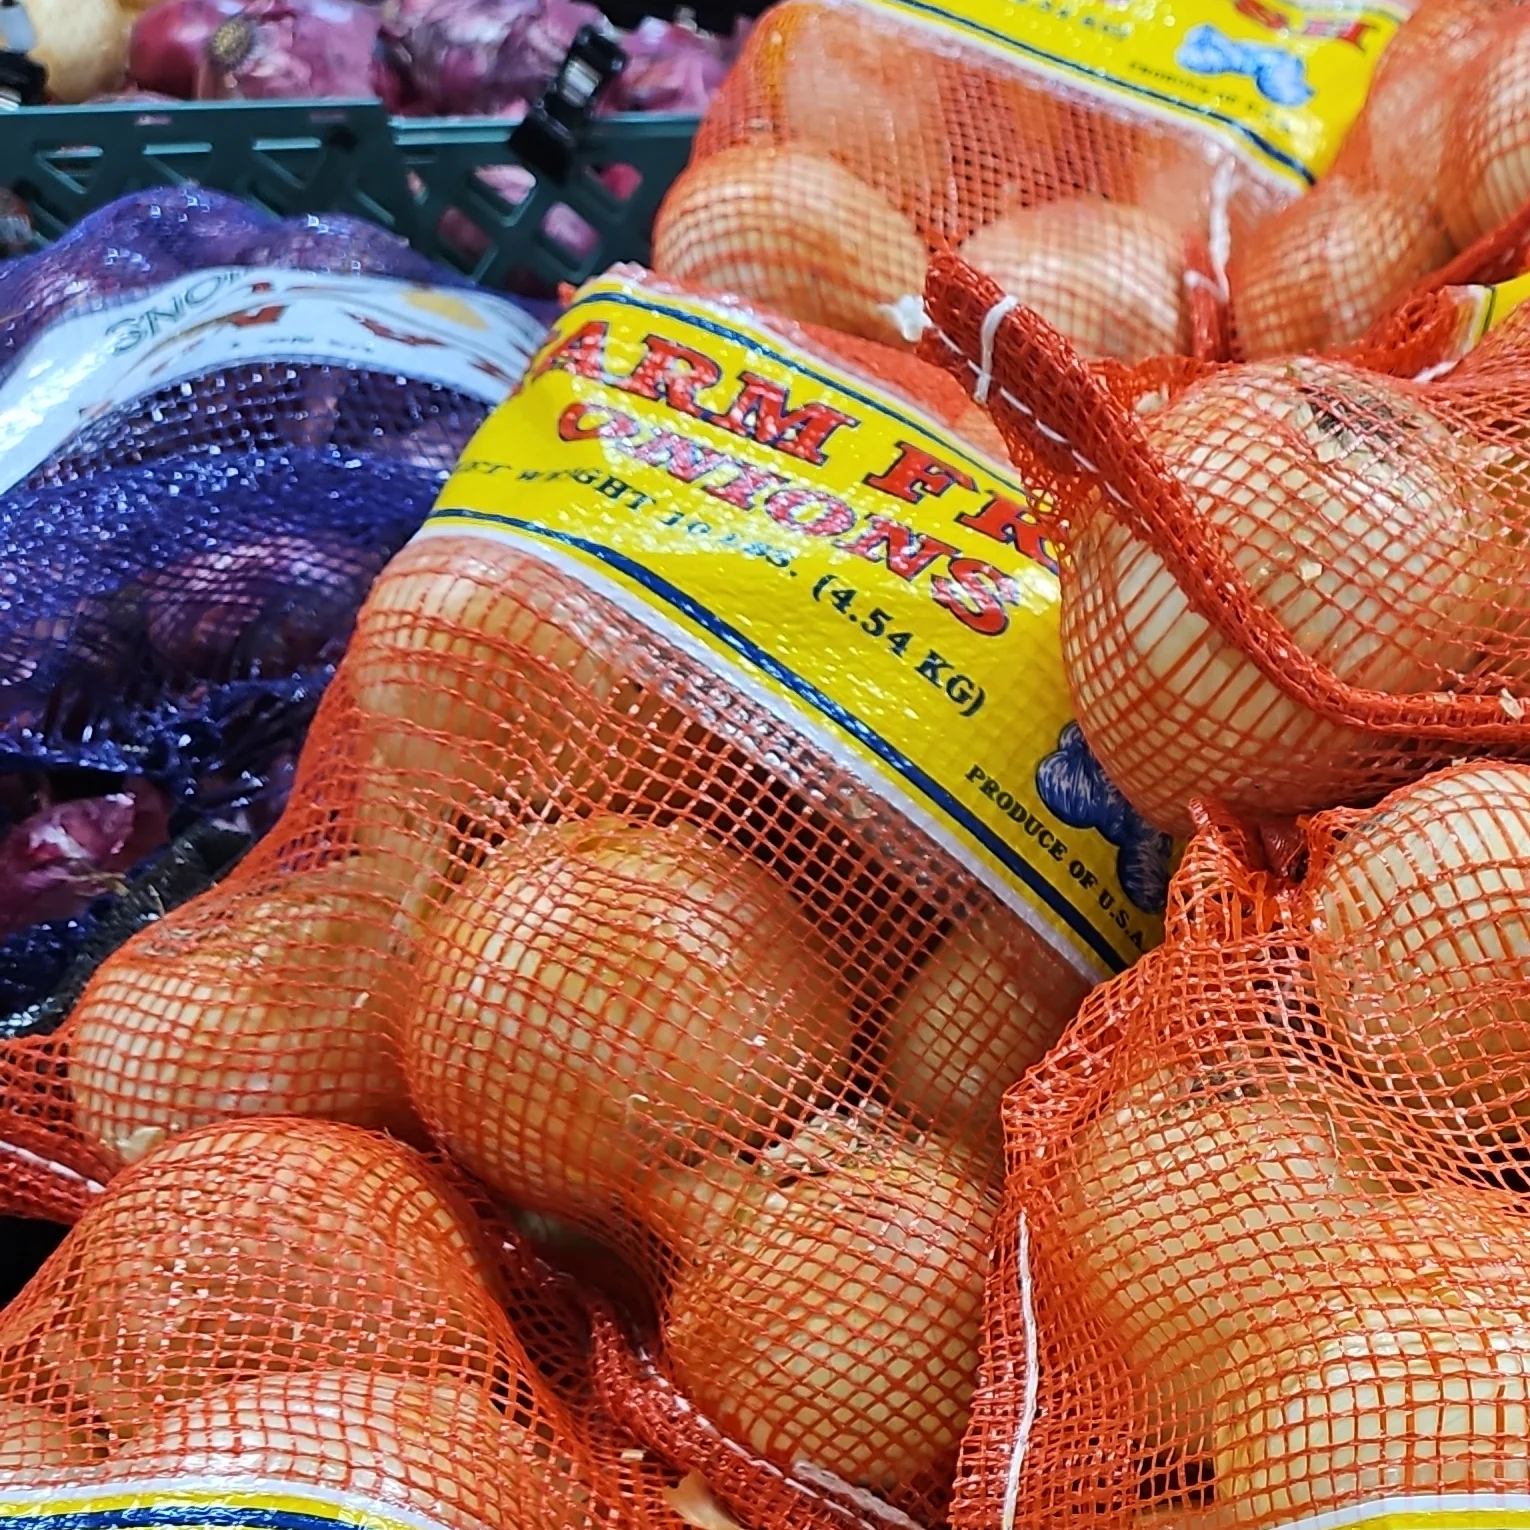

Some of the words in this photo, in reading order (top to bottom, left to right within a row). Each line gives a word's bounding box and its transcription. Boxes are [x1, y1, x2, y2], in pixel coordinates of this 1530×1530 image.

[558, 402, 1021, 637] ONIONS
[812, 574, 913, 658] (4.54
[914, 648, 987, 716] KG)
[964, 764, 1068, 863] PRODUCE
[1068, 859, 1098, 891] OF
